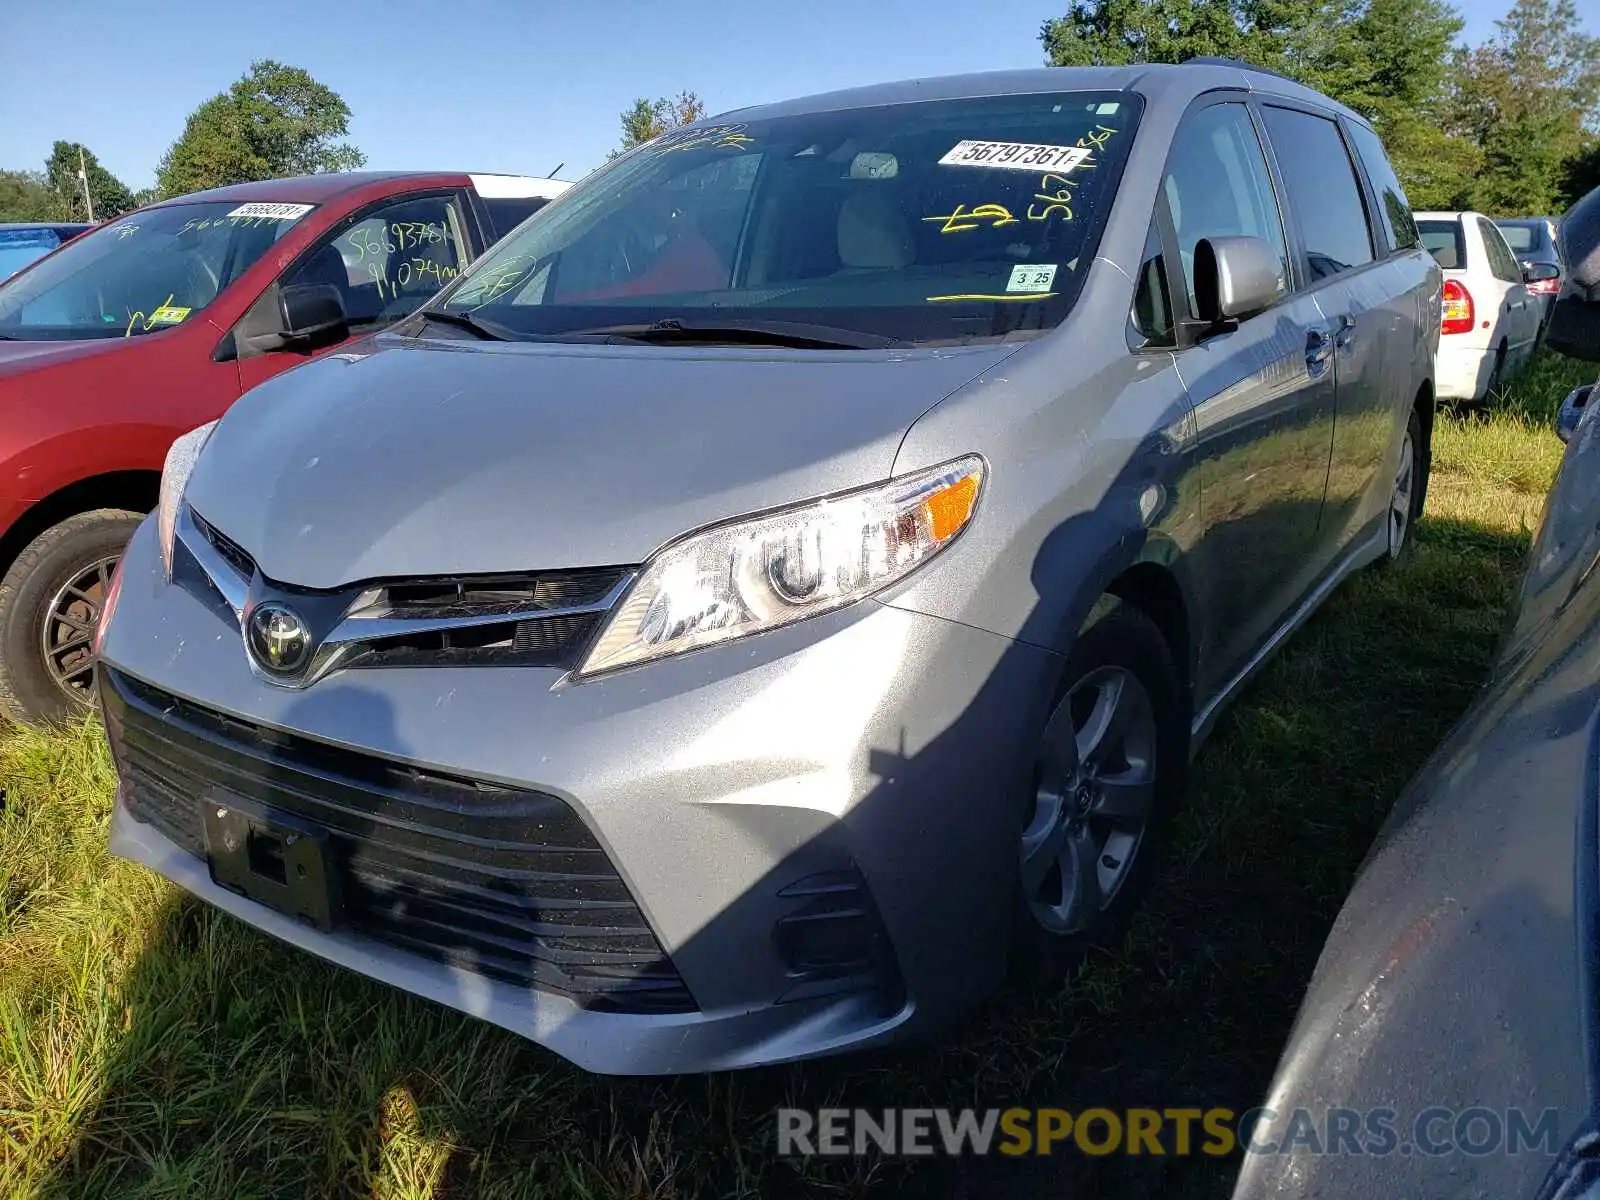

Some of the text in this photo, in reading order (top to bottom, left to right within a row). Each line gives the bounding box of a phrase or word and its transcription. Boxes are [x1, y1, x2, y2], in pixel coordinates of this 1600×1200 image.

[963, 143, 1071, 165] 56797361
[349, 211, 448, 264] 56693781
[1017, 273, 1050, 283] 3 25
